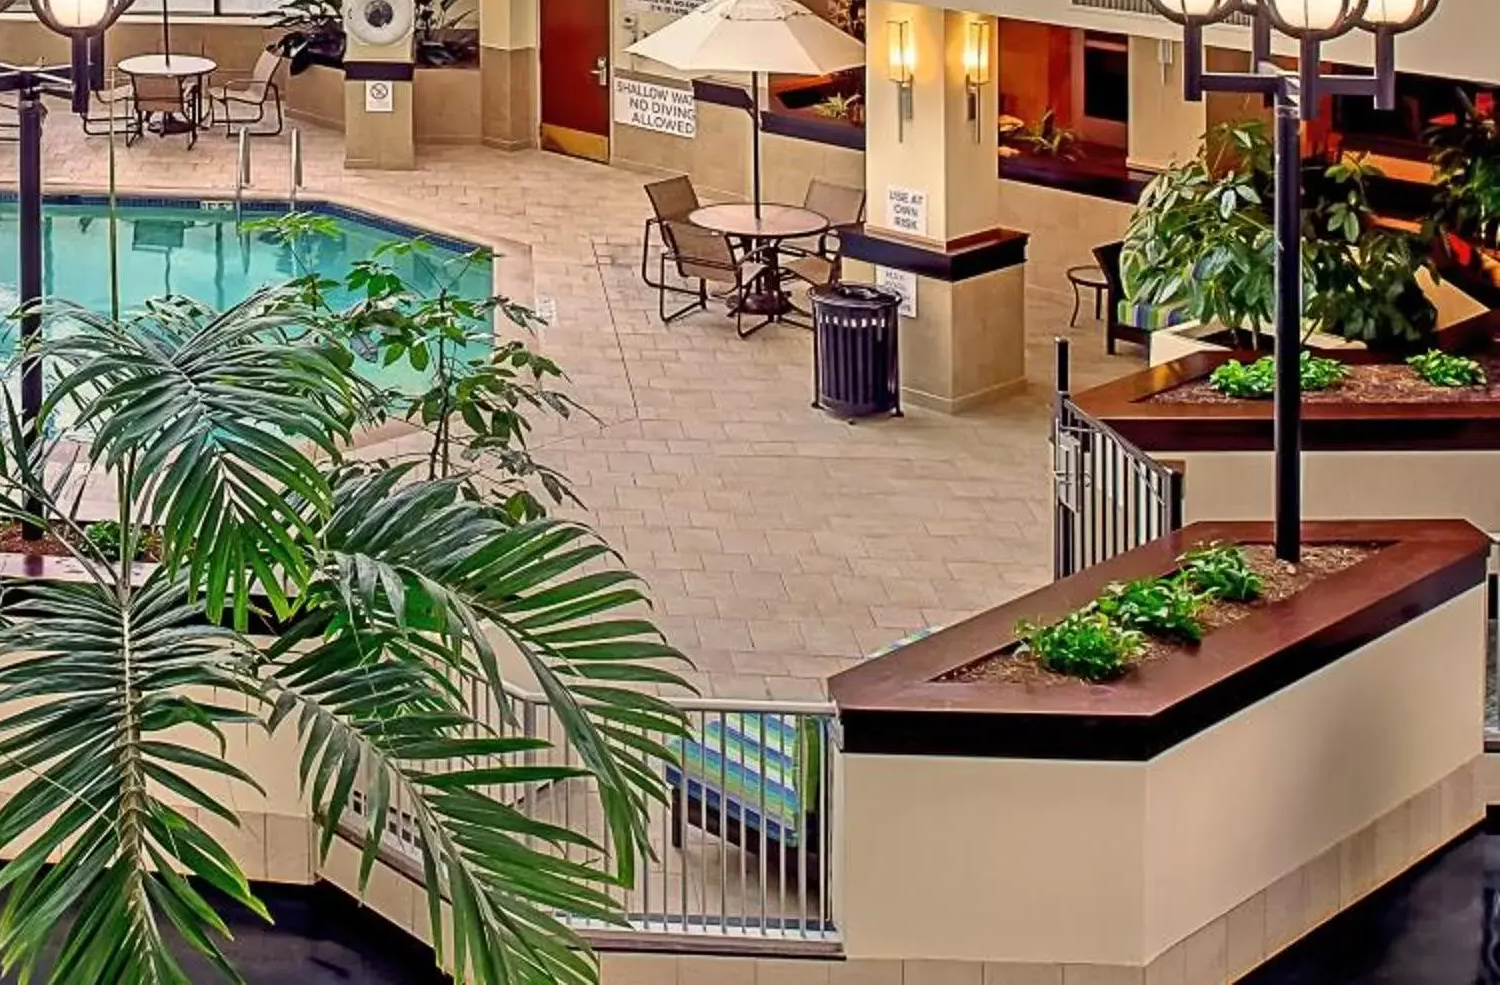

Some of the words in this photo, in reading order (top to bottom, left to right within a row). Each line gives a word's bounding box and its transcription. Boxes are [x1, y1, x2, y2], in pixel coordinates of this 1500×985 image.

[617, 81, 668, 102] SHALLOW
[629, 96, 649, 112] NO
[651, 102, 696, 120] DIVING
[631, 112, 695, 134] ALLOWED
[889, 190, 908, 203] USE
[893, 204, 918, 217] OWN
[894, 216, 918, 230] RISK
